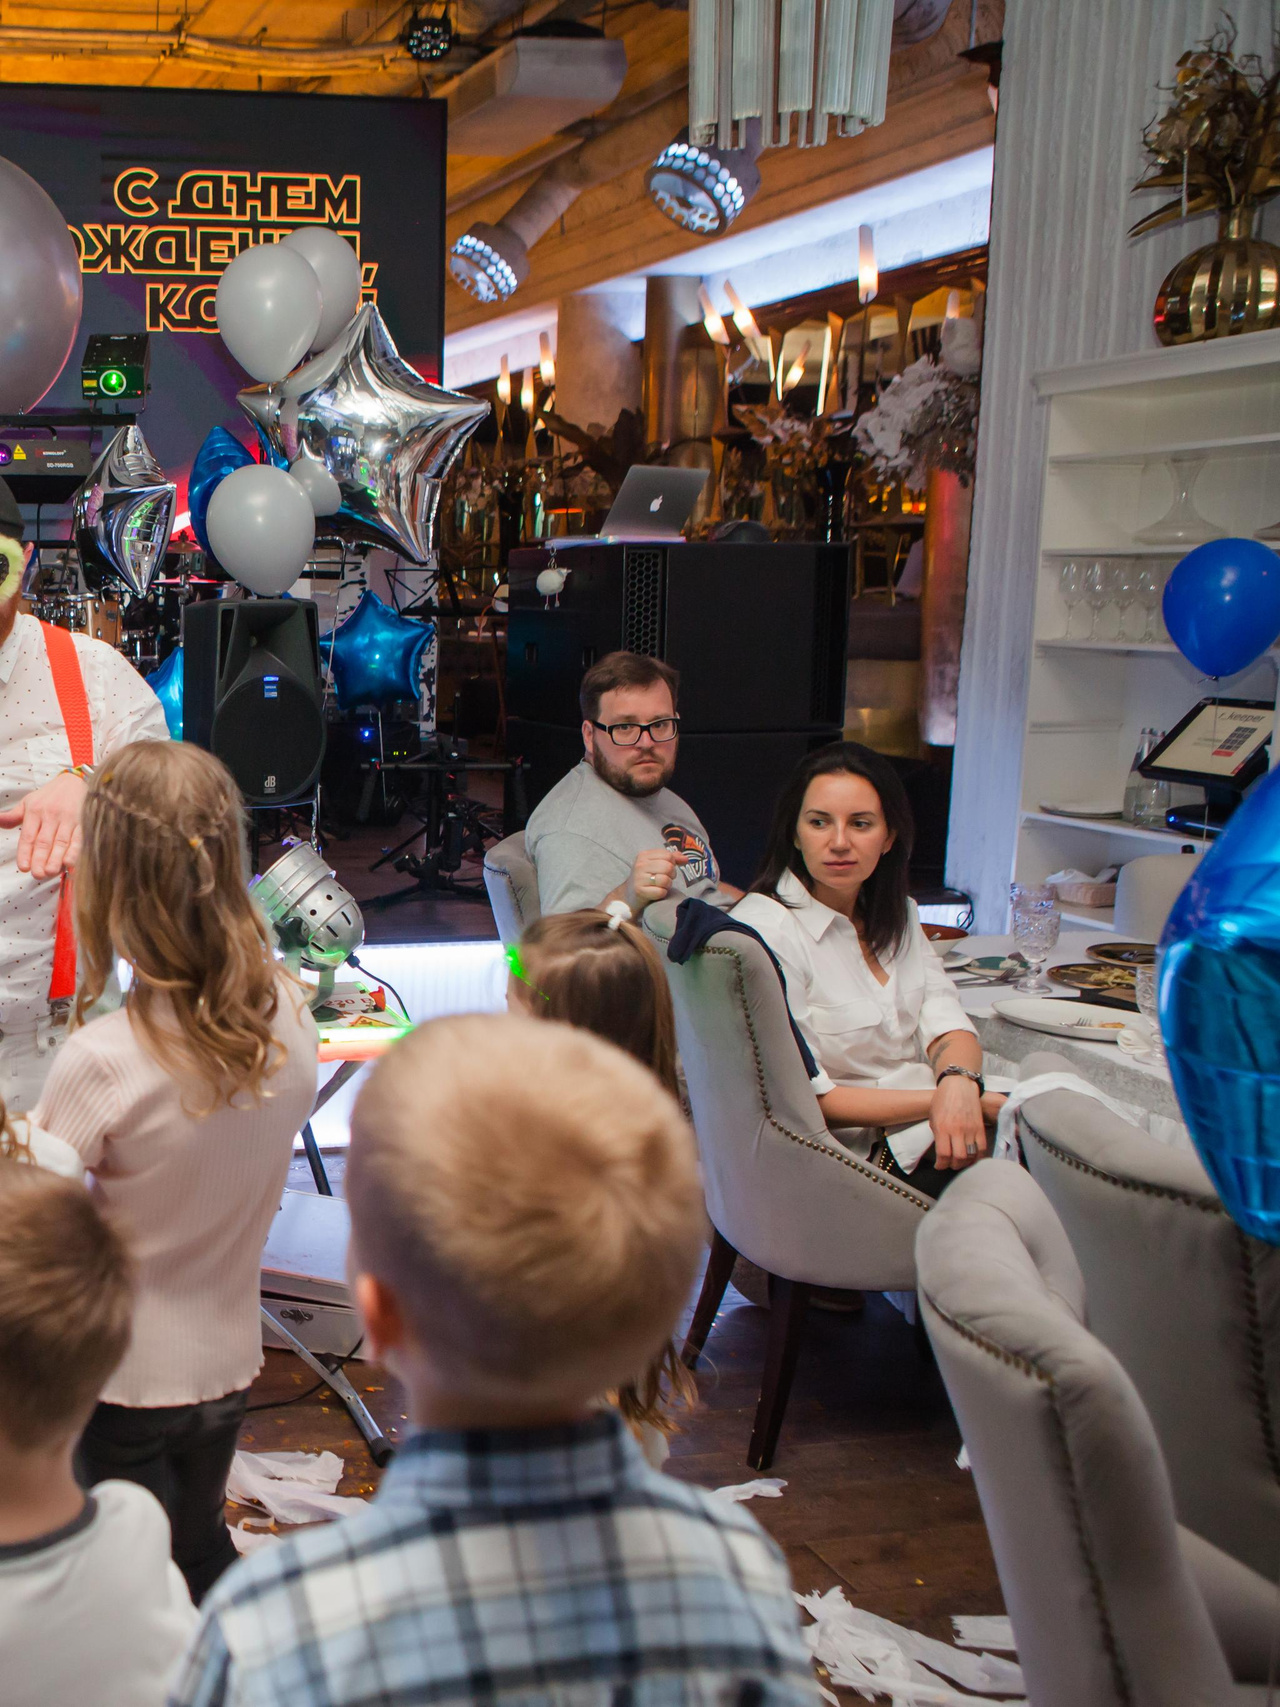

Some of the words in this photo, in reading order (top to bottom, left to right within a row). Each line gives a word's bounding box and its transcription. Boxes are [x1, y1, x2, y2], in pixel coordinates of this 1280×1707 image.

[114, 167, 159, 218] С
[168, 170, 360, 224] ДНЕМ
[264, 775, 276, 788] dB
